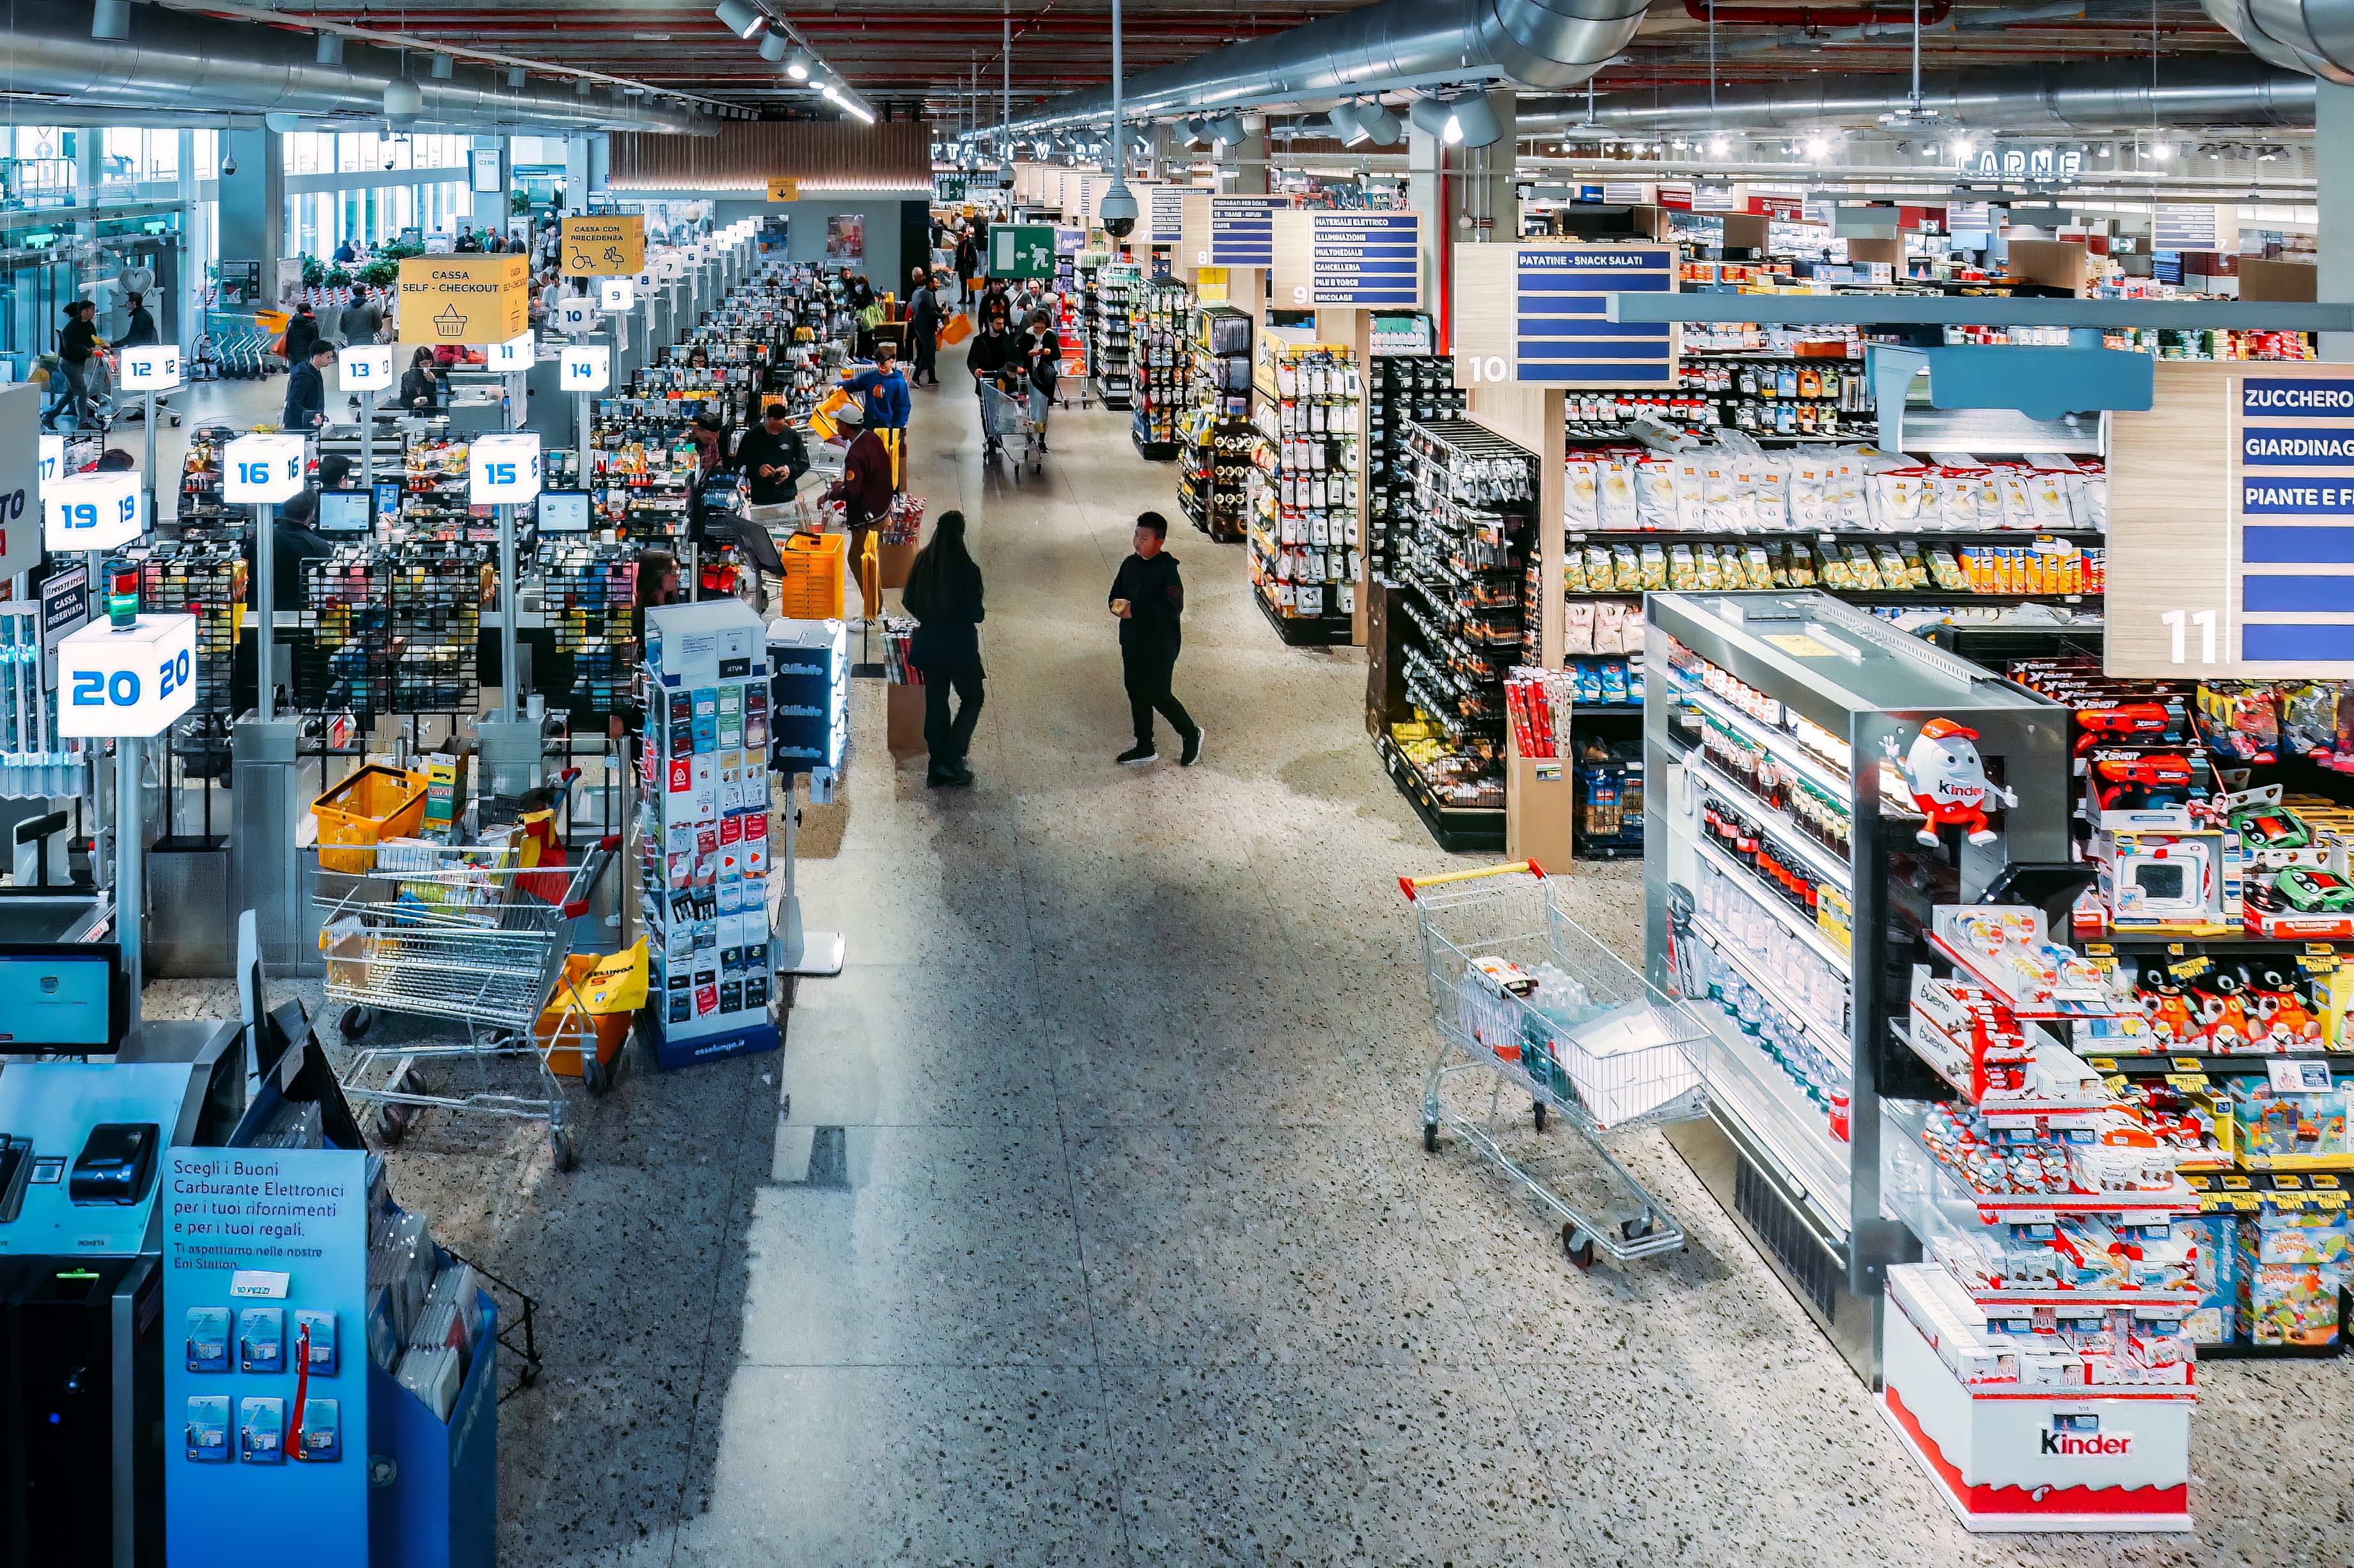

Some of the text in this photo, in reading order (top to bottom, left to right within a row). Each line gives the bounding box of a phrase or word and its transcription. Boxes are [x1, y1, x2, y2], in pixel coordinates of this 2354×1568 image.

[1198, 250, 1208, 265] 8
[1519, 256, 1567, 265] PATATINE
[1574, 256, 1607, 265] SNACK
[1608, 256, 1643, 265] SALATI
[432, 270, 470, 279] CASSA
[666, 263, 673, 272] 7
[402, 283, 428, 292] SELF
[439, 283, 499, 293] CHECKOUT
[641, 276, 650, 285] 8
[612, 291, 620, 301] 9
[1293, 286, 1308, 304] 9
[1315, 294, 1353, 302] BRICOLAGE
[566, 310, 583, 322] 10
[501, 345, 514, 359] 11
[131, 362, 152, 376] 12
[164, 359, 175, 375] 12
[350, 362, 370, 377] 13
[571, 363, 592, 378] 14
[1468, 356, 1508, 382] 10
[2245, 389, 2354, 407] ZUCCHERO
[39, 457, 56, 481] 17
[237, 462, 269, 484] 16
[287, 459, 299, 480] 16
[484, 462, 516, 485] 15
[2245, 488, 2318, 506] PIANTE
[2322, 489, 2335, 505] E
[61, 503, 97, 529] 19
[118, 494, 135, 523] 19
[54, 593, 77, 611] CASSA
[47, 602, 84, 626] RISERVATA
[2161, 609, 2216, 664] 11
[159, 648, 190, 700] 20
[73, 670, 141, 706] 20
[1920, 984, 1950, 1013] bueno
[1919, 1024, 1949, 1054] bueno
[174, 1159, 220, 1177] Scegli
[234, 1161, 279, 1177] Buoni
[174, 1180, 344, 1198] Carburante Elettronici
[174, 1203, 198, 1216] per
[212, 1200, 240, 1215] tuoi
[246, 1201, 337, 1217] rifornimenti
[174, 1222, 182, 1233] e
[188, 1223, 212, 1236] per
[224, 1221, 255, 1235] tuoi
[259, 1221, 306, 1239] regali.
[174, 1243, 323, 1258] Ti aspettiamo nelle nostre
[174, 1258, 237, 1270] Eni Station
